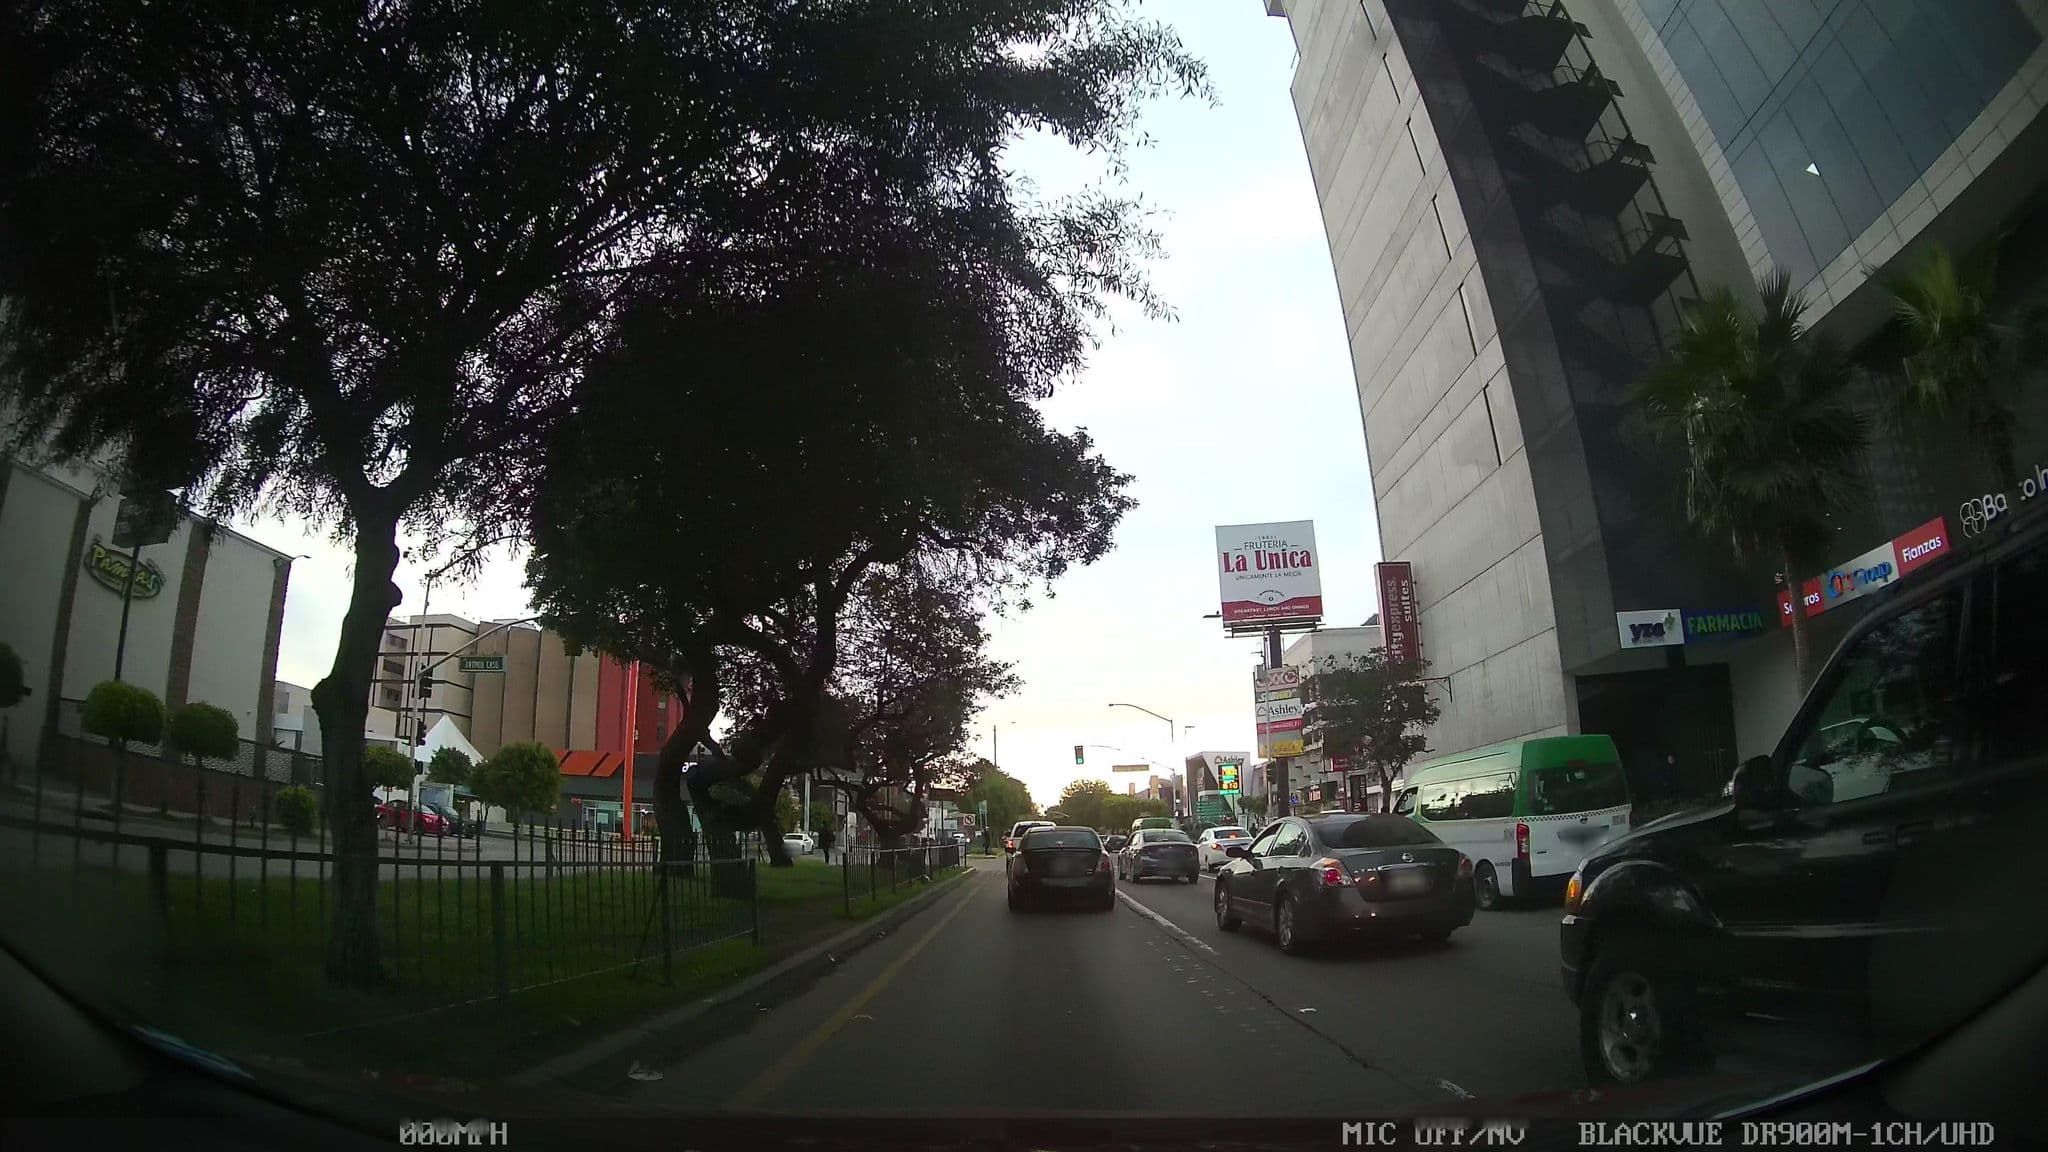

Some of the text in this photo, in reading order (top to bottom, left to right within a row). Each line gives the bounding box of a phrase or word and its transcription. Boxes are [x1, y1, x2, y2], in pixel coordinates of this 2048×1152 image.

[1983, 478, 2036, 521] Bao
[1244, 540, 1288, 550] FRUTERIA
[1902, 535, 1942, 563] Fianzas
[1223, 549, 1312, 573] La Unica
[1401, 579, 1412, 622] suites
[1783, 592, 1820, 614] Sros
[1687, 611, 1764, 634] FARMACIA
[1258, 688, 1296, 702] SBWAY
[1269, 703, 1299, 716] Ashley
[1223, 755, 1245, 764] Ashley
